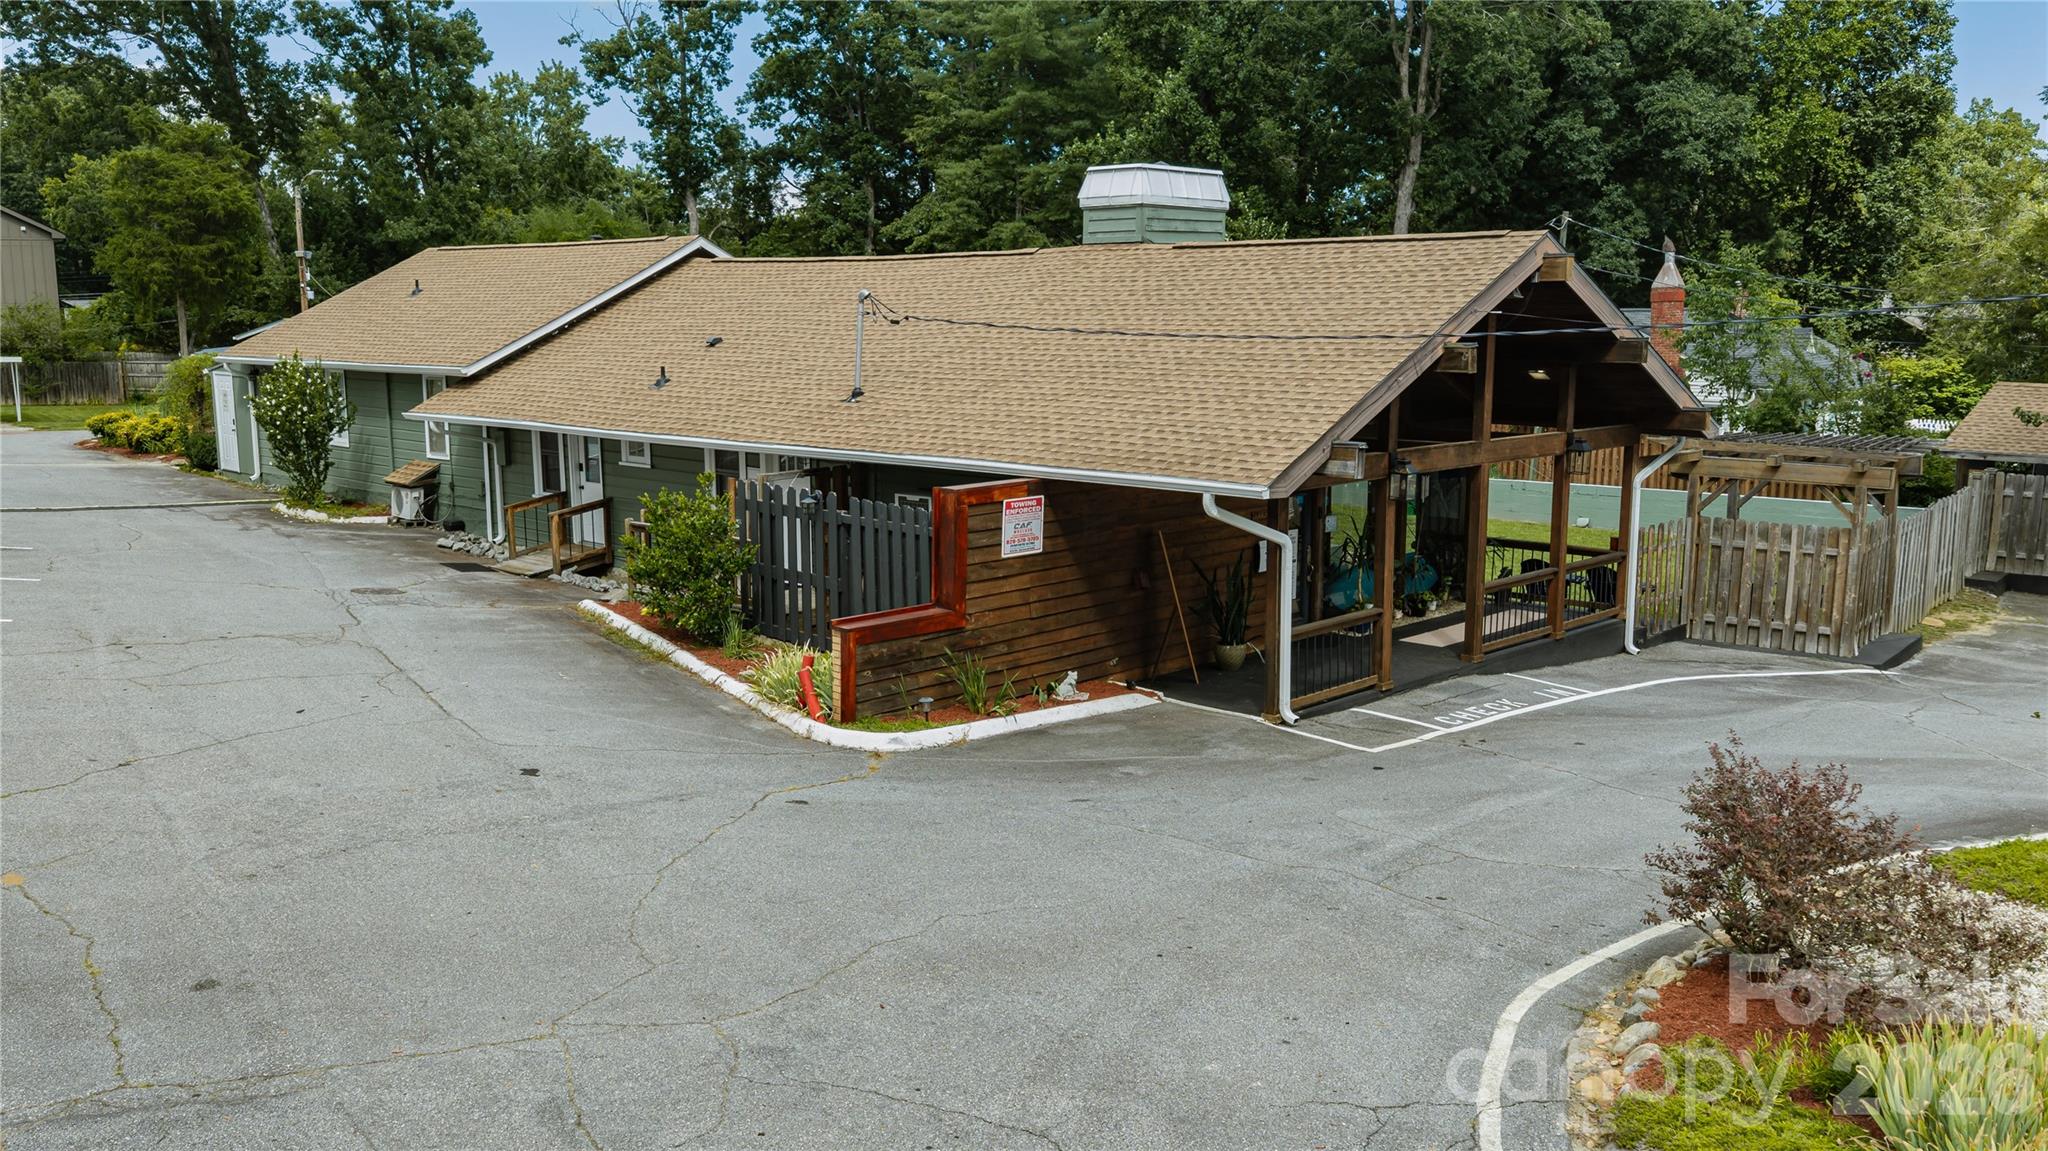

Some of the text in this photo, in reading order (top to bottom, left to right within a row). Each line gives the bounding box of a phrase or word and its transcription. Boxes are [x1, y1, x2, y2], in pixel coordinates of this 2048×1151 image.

[1011, 500, 1037, 508] TOWING
[1006, 505, 1041, 515] ENFORCED
[1434, 687, 1577, 726] CHECK IN
